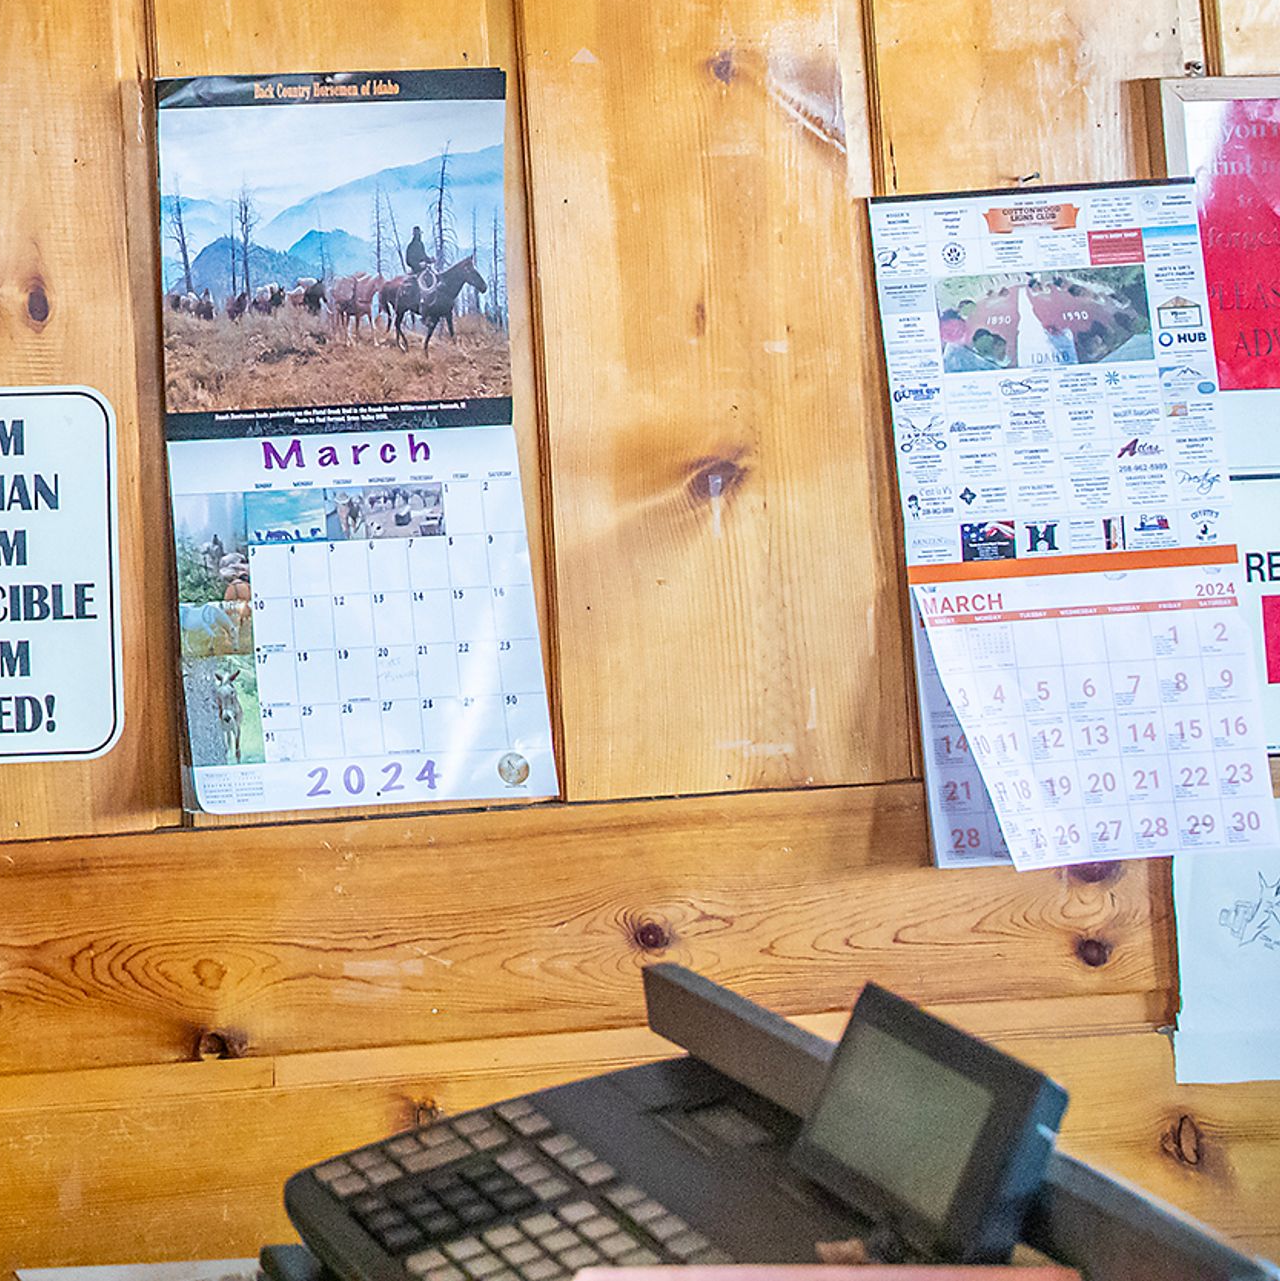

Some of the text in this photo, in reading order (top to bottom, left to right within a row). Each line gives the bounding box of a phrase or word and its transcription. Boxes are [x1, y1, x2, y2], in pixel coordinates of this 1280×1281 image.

[276, 83, 311, 101] Country
[361, 81, 371, 96] of
[372, 80, 400, 96] Idaho
[1176, 332, 1207, 345] HUB
[261, 433, 432, 471] March
[922, 581, 1236, 615] MARCH 2024
[1168, 622, 1229, 645] 1 2
[1082, 669, 1234, 698] 6 9
[1129, 716, 1248, 743] 14 16
[305, 759, 443, 799] 2024
[1179, 766, 1210, 787] 22
[1095, 811, 1261, 842] 27 30
